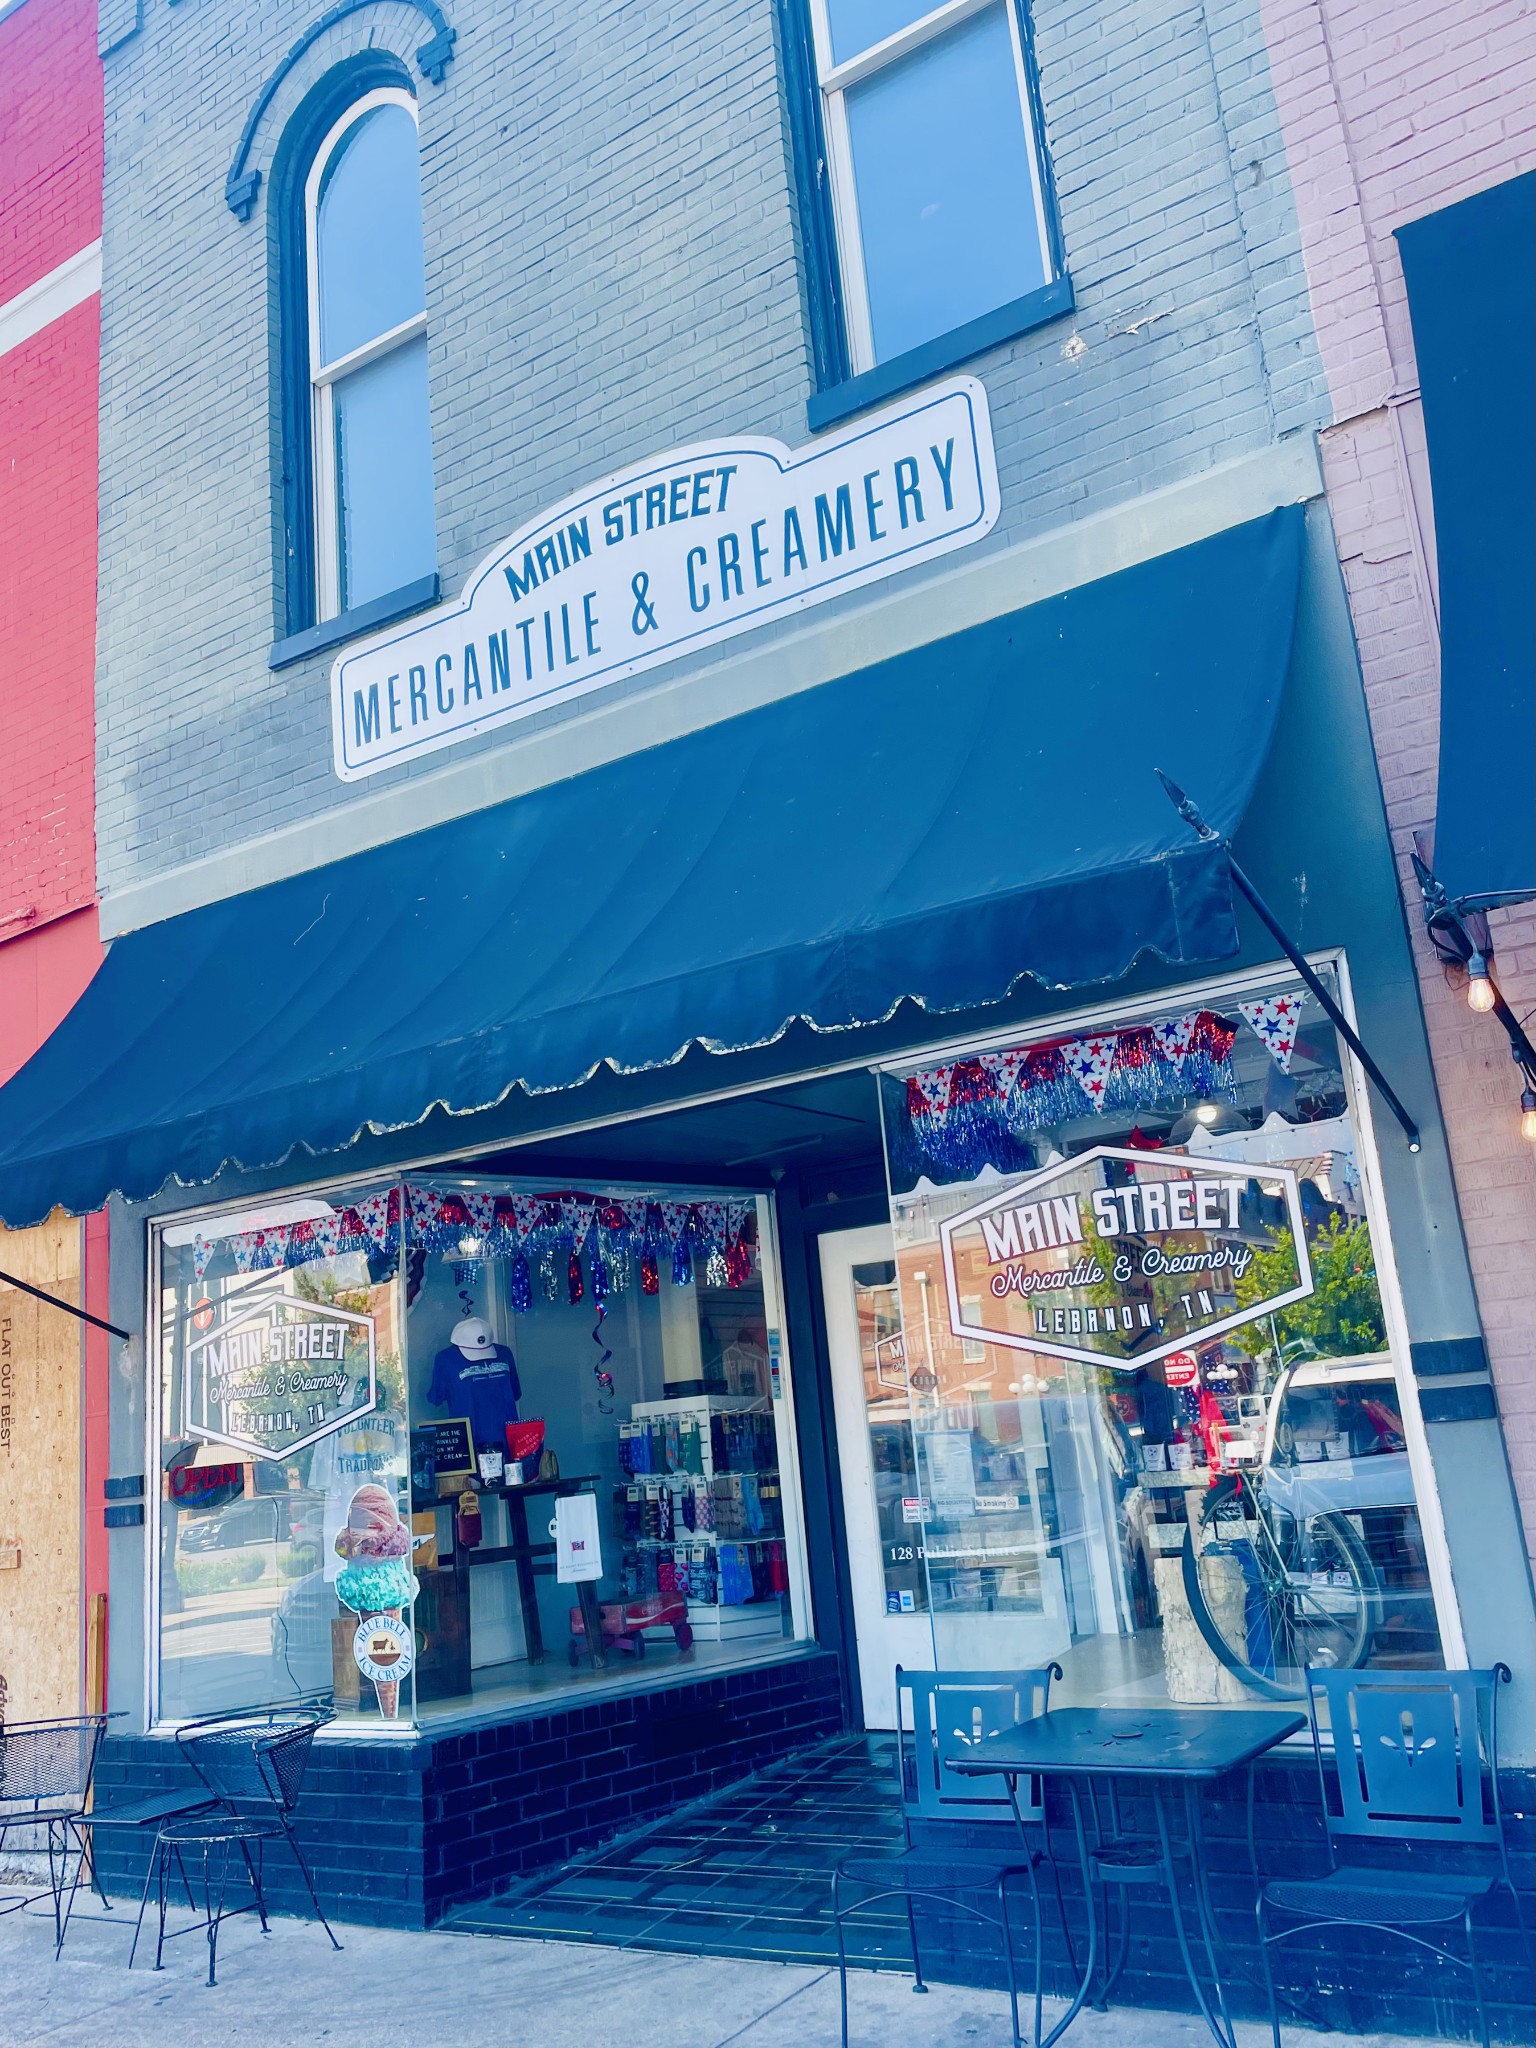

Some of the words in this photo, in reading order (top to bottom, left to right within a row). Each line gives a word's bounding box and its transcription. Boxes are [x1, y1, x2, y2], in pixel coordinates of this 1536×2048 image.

[502, 515, 590, 604] MAIN
[603, 464, 738, 546] STREET
[353, 589, 601, 748] MERCANTILE
[630, 570, 660, 636] &
[686, 437, 958, 613] CREAMERY
[979, 1193, 1083, 1265] MAIN
[1091, 1179, 1247, 1237] STREET
[991, 1256, 1104, 1298] Mercantile
[1113, 1255, 1132, 1282] &
[1141, 1245, 1253, 1280] Creamery
[1037, 1302, 1166, 1334] LEBANON,
[1180, 1289, 1214, 1320] TN
[1, 1317, 12, 1358] FLAT
[206, 1328, 264, 1378] MAIN
[268, 1323, 350, 1362] STREET
[1, 1363, 12, 1399] OUT
[210, 1378, 271, 1405] Mercantile
[275, 1380, 285, 1396] &
[290, 1371, 348, 1395] Creamery
[307, 1403, 326, 1425] TN
[170, 1462, 239, 1496] OPEN
[890, 1546, 913, 1560] 128
[358, 1617, 380, 1642] BLUE
[383, 1617, 407, 1640] BELL
[359, 1656, 377, 1676] ICE
[377, 1654, 412, 1681] CREAM
